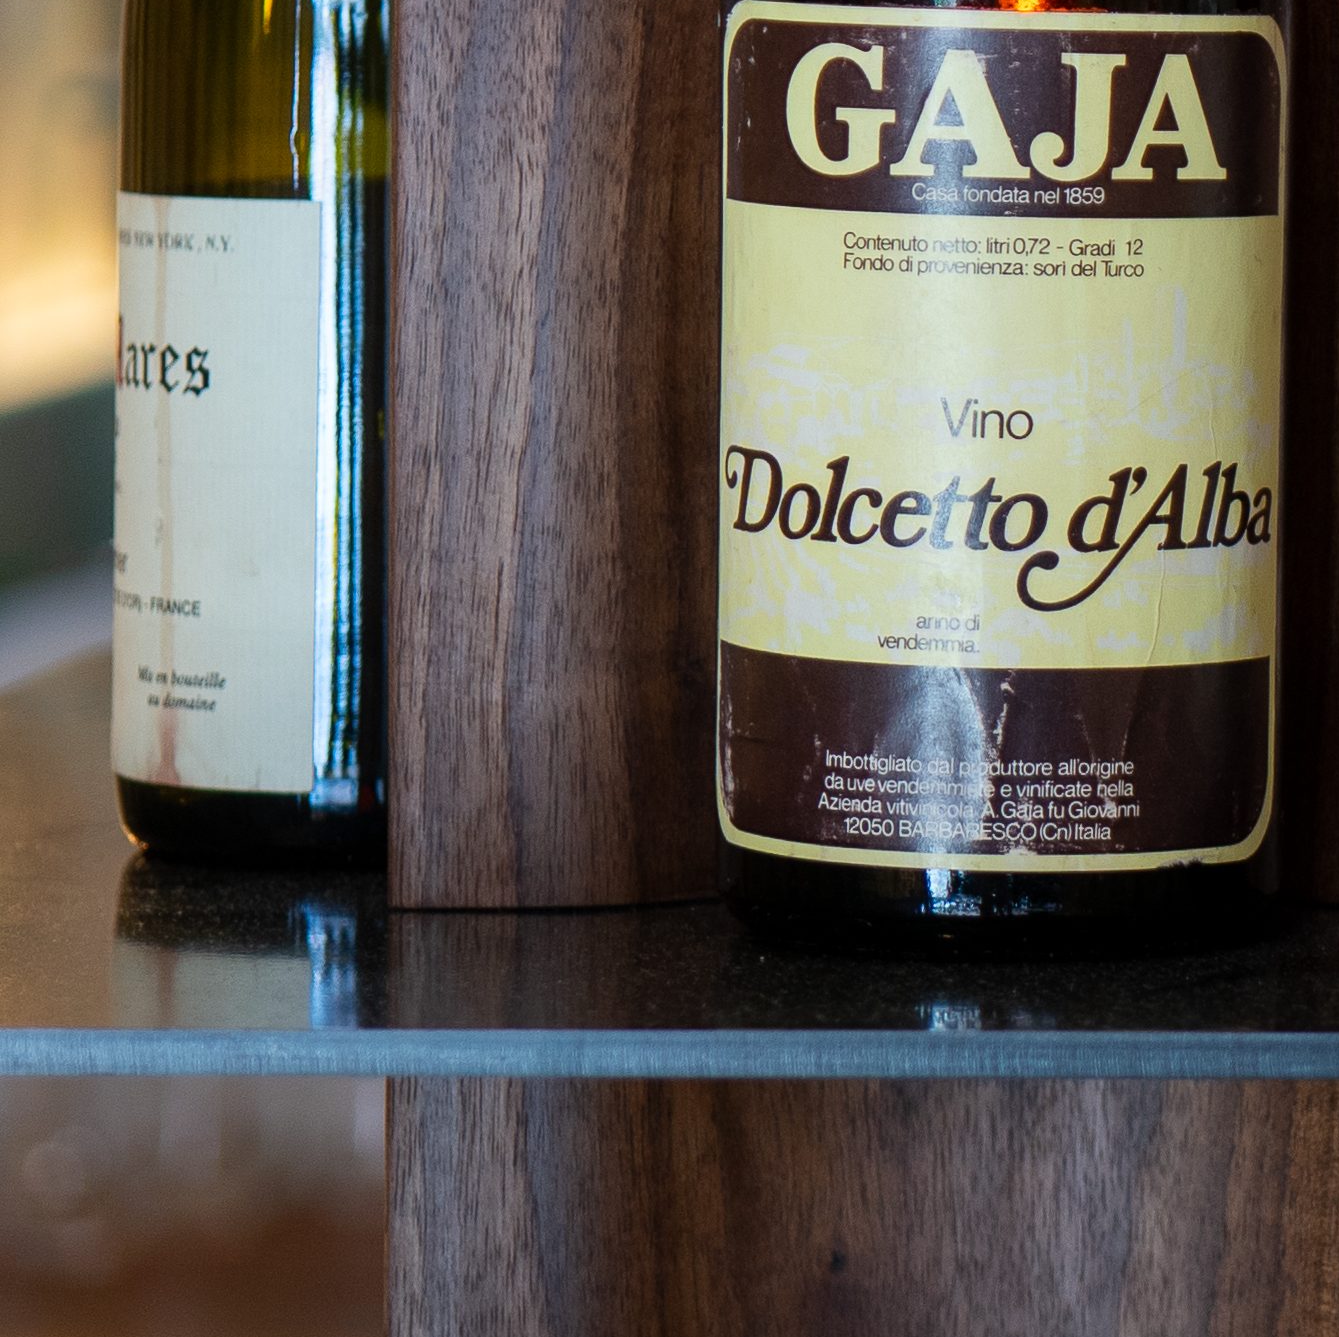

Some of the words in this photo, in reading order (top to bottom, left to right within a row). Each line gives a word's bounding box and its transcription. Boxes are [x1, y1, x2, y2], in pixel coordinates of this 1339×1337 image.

[785, 42, 1227, 183] GAJA
[911, 182, 959, 202] Casa
[962, 184, 1030, 204] fondata
[1033, 185, 1060, 204] nel
[1063, 187, 1105, 206] 1859
[843, 232, 929, 253] Contenuto
[932, 234, 982, 255] netto:
[986, 235, 1010, 255] litri
[1012, 237, 1050, 257] 0,72
[1069, 238, 1116, 257] Gradi
[1125, 239, 1143, 256] 12
[843, 254, 894, 273] Fondo
[899, 254, 914, 274] di
[917, 257, 1030, 278] provenienza:
[1070, 259, 1098, 278] del
[1102, 259, 1144, 279] Turco
[940, 397, 1034, 440] Vino
[725, 444, 1050, 552] Dolcetto
[1016, 460, 1273, 612] d'Alba
[150, 596, 201, 616] FRANCE
[965, 613, 980, 631] di
[825, 749, 922, 777] Imbottigliato
[929, 758, 955, 776] dal
[1057, 758, 1135, 780] all'origine
[824, 772, 845, 791] da
[846, 777, 875, 794] uve
[999, 783, 1012, 798] e
[1016, 780, 1091, 798] vinificate
[1096, 780, 1134, 797] nella
[817, 792, 882, 814] Azienda
[1000, 801, 1044, 823] Gaja
[1047, 800, 1065, 819] fu
[1068, 800, 1141, 818] Giovanni
[843, 817, 894, 837] 12050
[898, 819, 1037, 842] BARBARESCO
[1039, 823, 1072, 842] (Cn)
[1074, 824, 1112, 841] Italia
